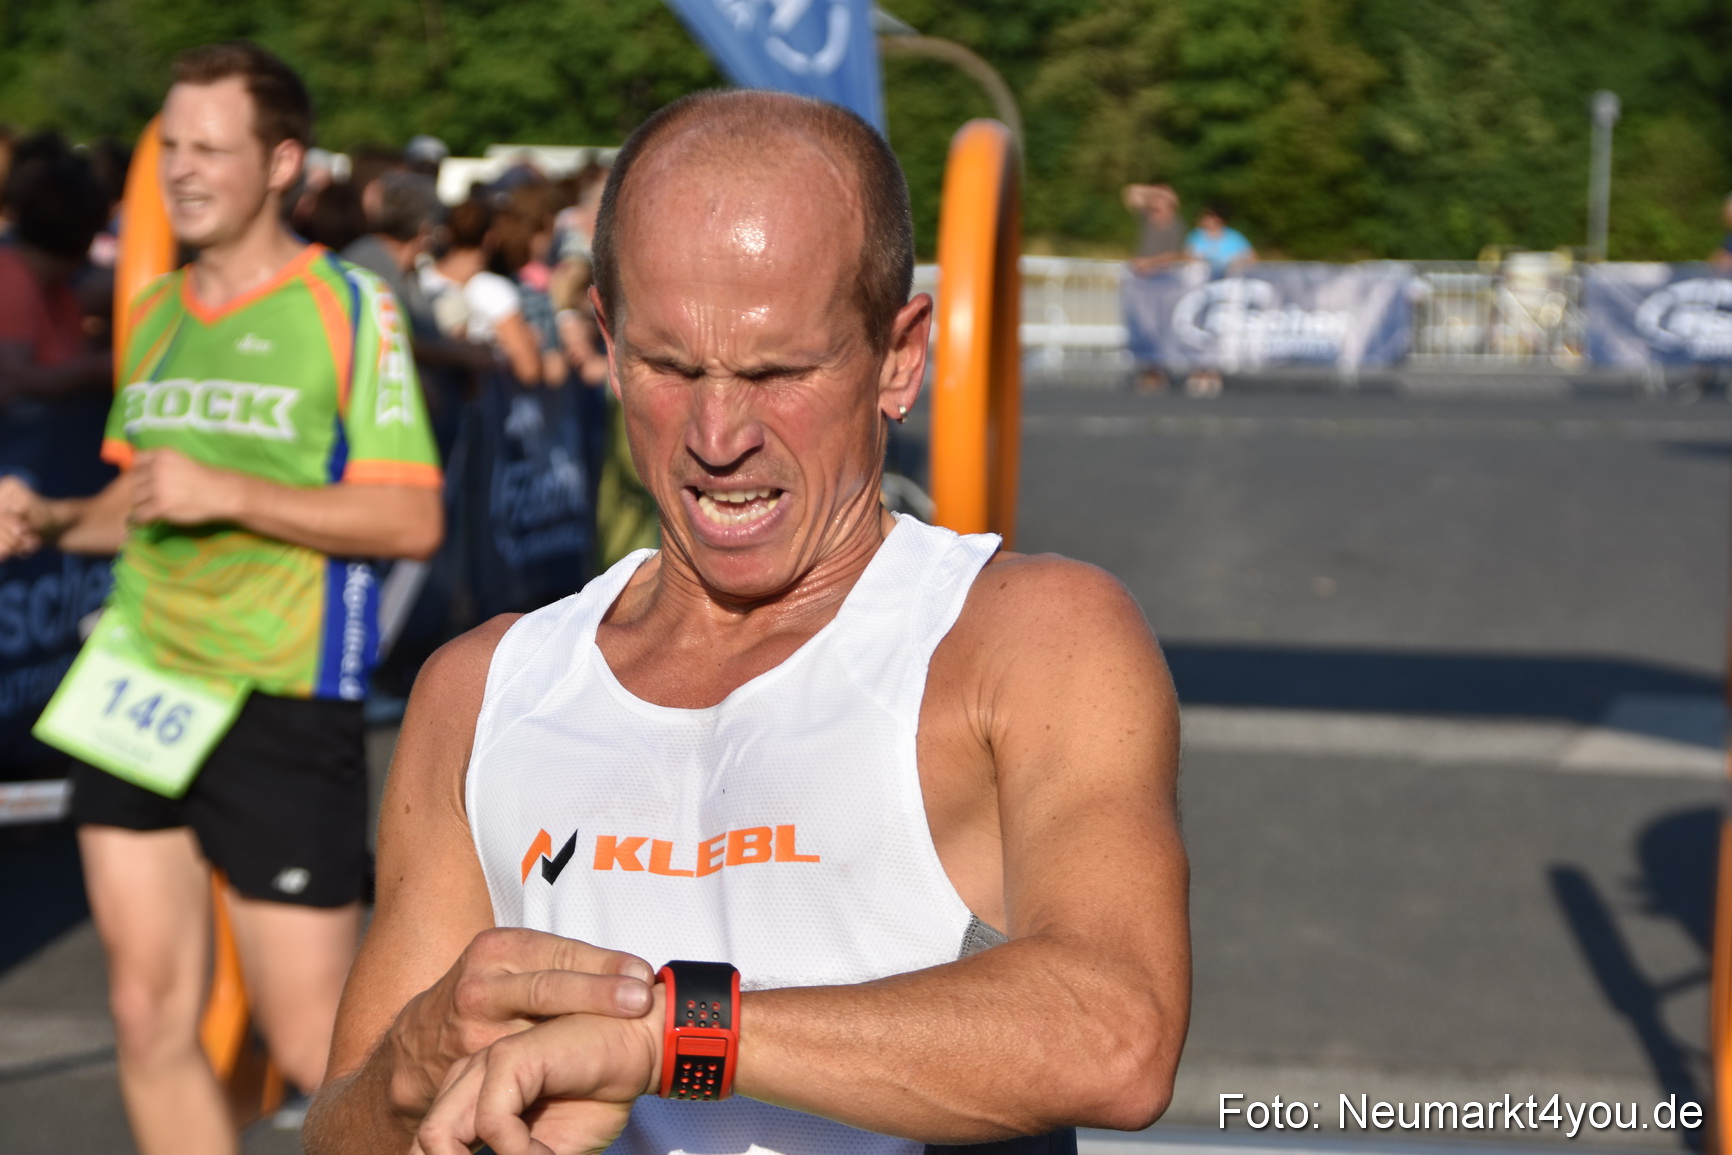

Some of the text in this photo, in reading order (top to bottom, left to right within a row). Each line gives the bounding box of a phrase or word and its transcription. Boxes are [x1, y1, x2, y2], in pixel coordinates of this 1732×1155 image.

[124, 378, 300, 440] BOCK
[104, 677, 193, 746] 146
[592, 824, 821, 878] KLEBL
